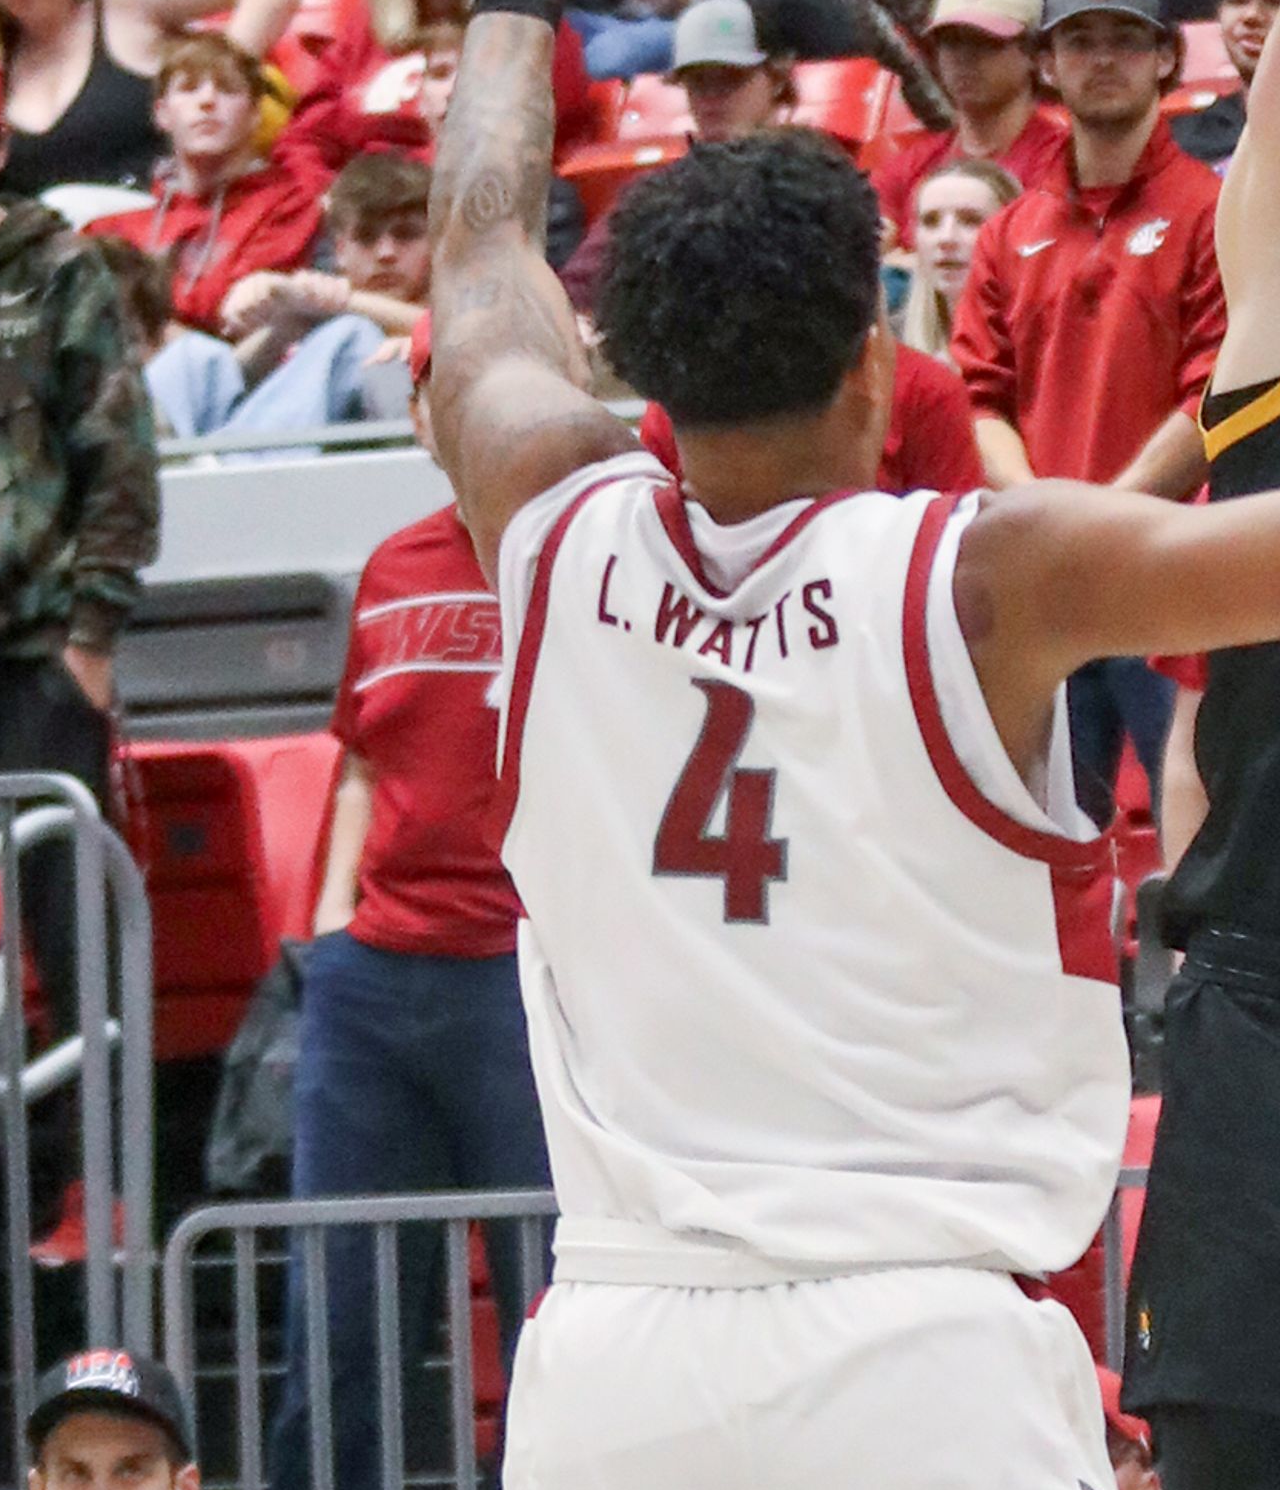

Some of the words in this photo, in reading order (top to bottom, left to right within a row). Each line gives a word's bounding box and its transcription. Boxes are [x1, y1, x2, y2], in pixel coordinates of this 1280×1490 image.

[597, 554, 632, 633] L.
[654, 578, 840, 674] WATTS
[651, 676, 790, 926] 4
